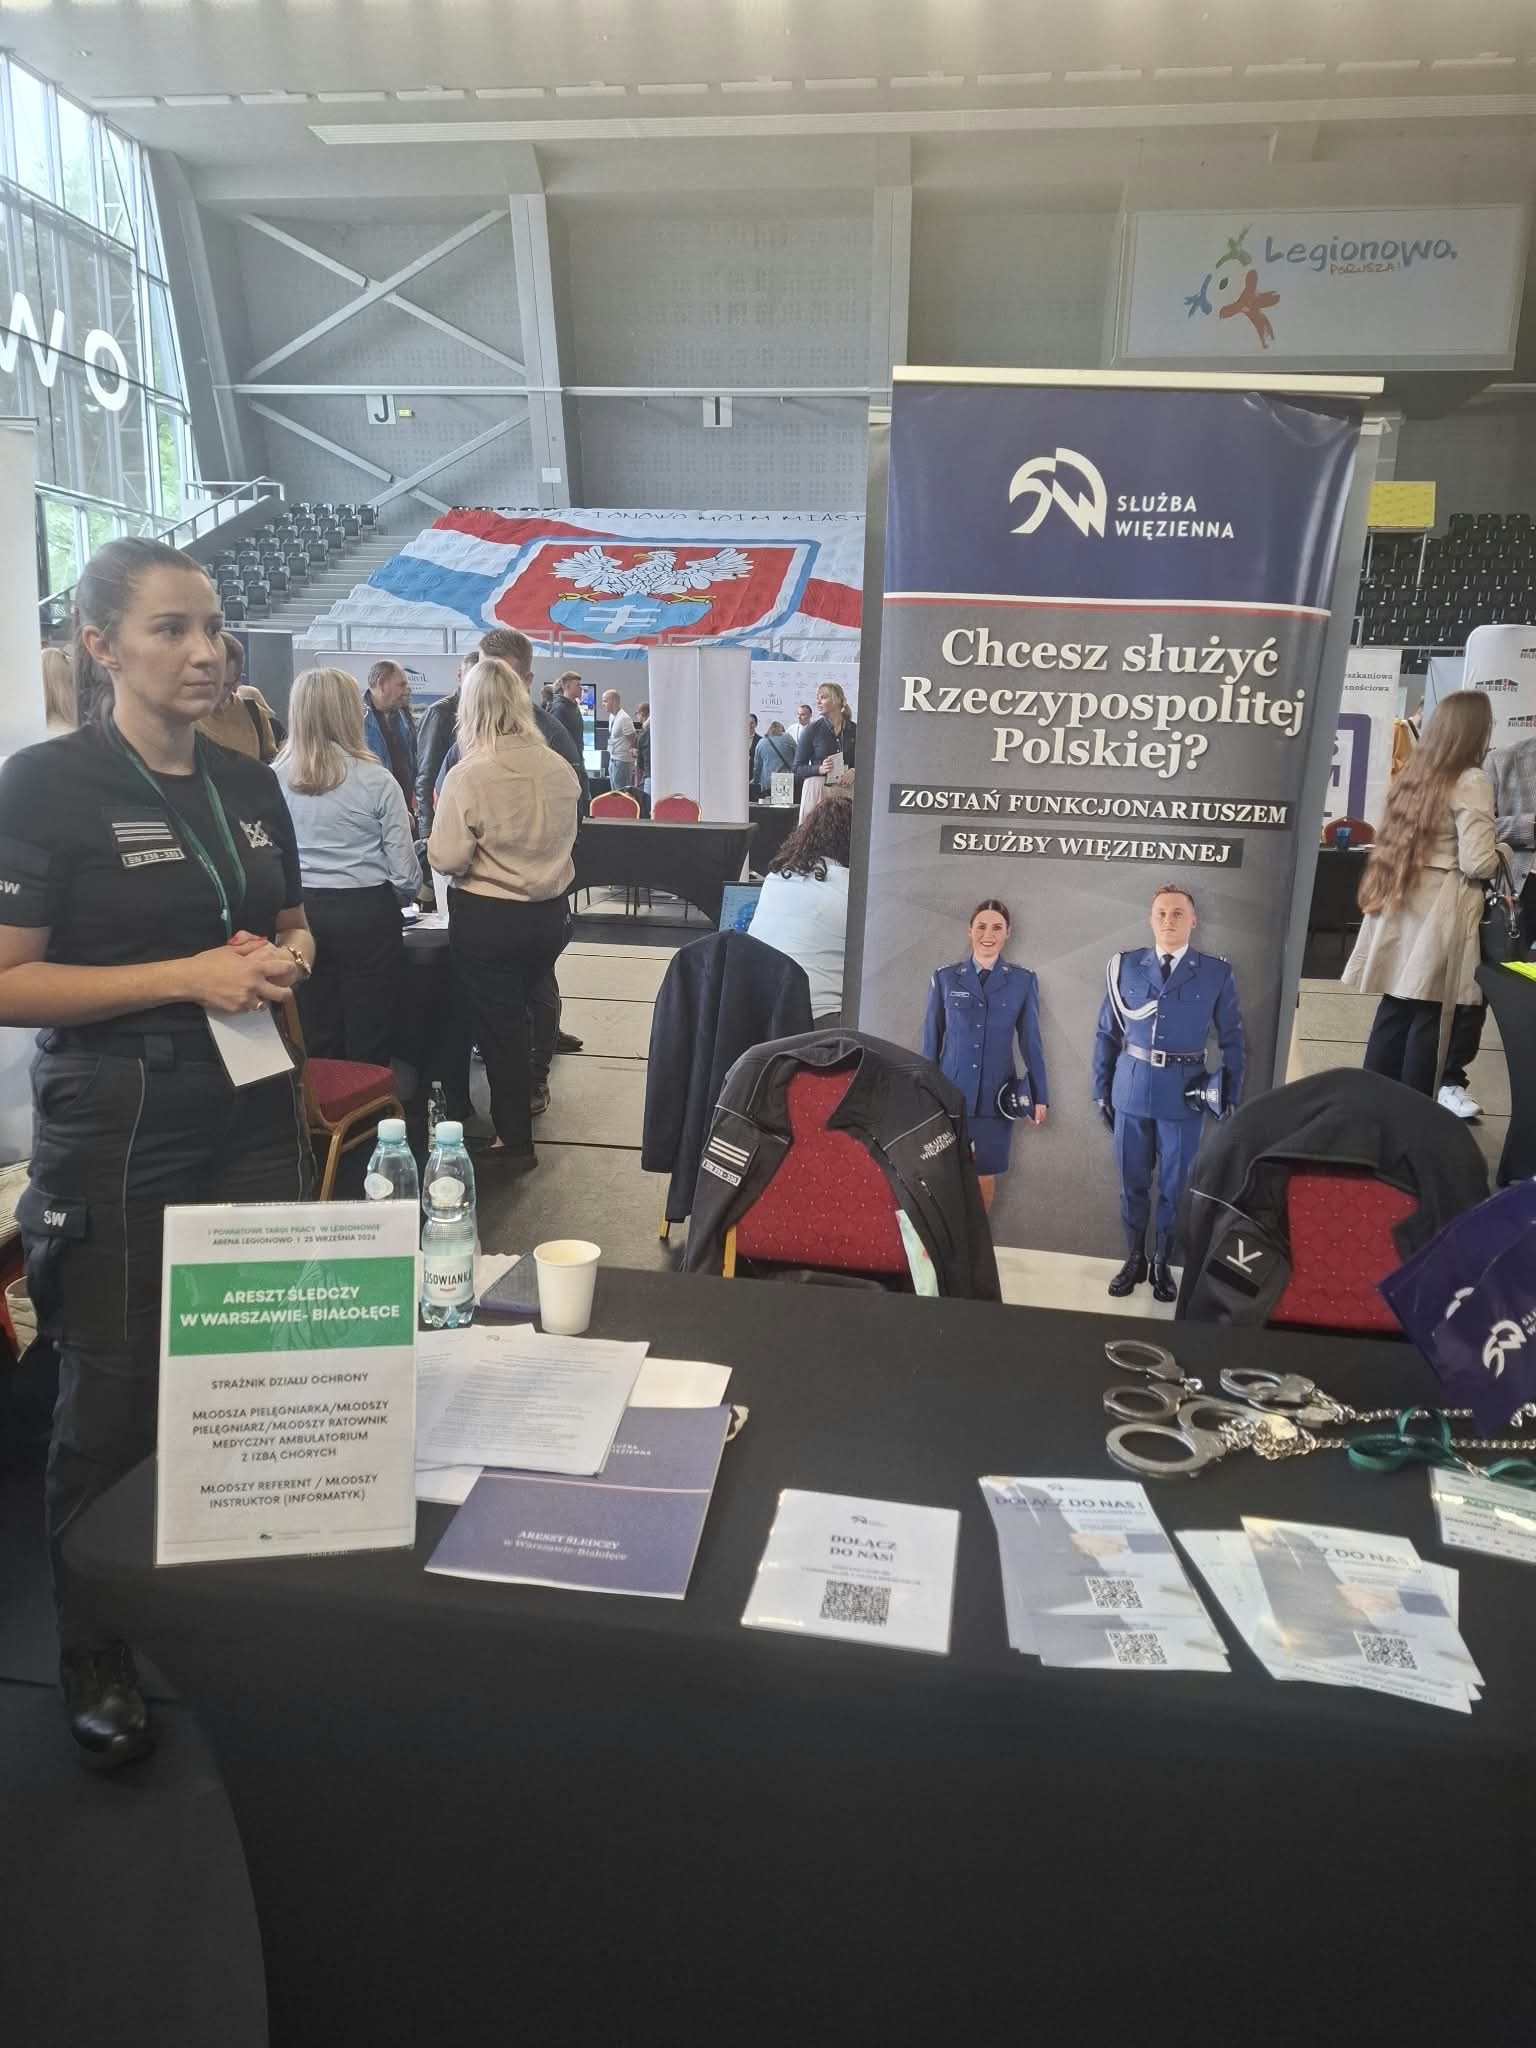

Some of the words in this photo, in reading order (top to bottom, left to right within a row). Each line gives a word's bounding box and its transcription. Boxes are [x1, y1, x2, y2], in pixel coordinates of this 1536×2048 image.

[1117, 492, 1197, 512] SŁUŻBA
[1115, 520, 1234, 540] WIĘZIENNA
[942, 628, 1107, 671] Chcesz
[1122, 634, 1278, 685] służyć
[1344, 683, 1390, 692] snościowa
[899, 676, 1305, 737] Rzeczypospolitej
[991, 727, 1209, 779] Polskiej?
[900, 789, 1000, 812] ZOSTAŃ
[1008, 795, 1287, 824] FUNKCJONARIUSZEM
[953, 831, 1052, 854] SŁUŻBY
[1057, 837, 1232, 863] WIĘZIENNEJ
[43, 1210, 67, 1227] SW
[223, 1288, 283, 1304] ARESZT
[287, 1286, 360, 1302] ŚLEDCZY
[180, 1313, 199, 1327] W
[312, 1305, 400, 1321] BIAŁOŁĘCE
[211, 1376, 266, 1390] STRAŻNIK
[269, 1376, 307, 1387] DZIAŁU
[311, 1373, 368, 1385] OCHRONY
[192, 1408, 247, 1420] MŁODSZA
[328, 1415, 388, 1427] RATOWNIK
[212, 1437, 276, 1449] MEDYCZNY
[279, 1431, 368, 1446] AMBULATORIUM
[242, 1453, 248, 1463] Z
[251, 1451, 277, 1463] IZBĄ
[280, 1447, 336, 1460] CHORYCH
[200, 1482, 254, 1495] MŁODSZY
[257, 1478, 311, 1491] REFERENT
[325, 1474, 378, 1486] MŁODSZY
[210, 1496, 280, 1509] INSTRUKTOR
[283, 1490, 365, 1508] (INFORMATYK)
[1069, 1499, 1096, 1507] DO
[830, 1534, 897, 1550] DOŁĄCZ
[829, 1547, 853, 1557] DO
[857, 1550, 894, 1562] NAS!
[1336, 1549, 1365, 1559] DO
